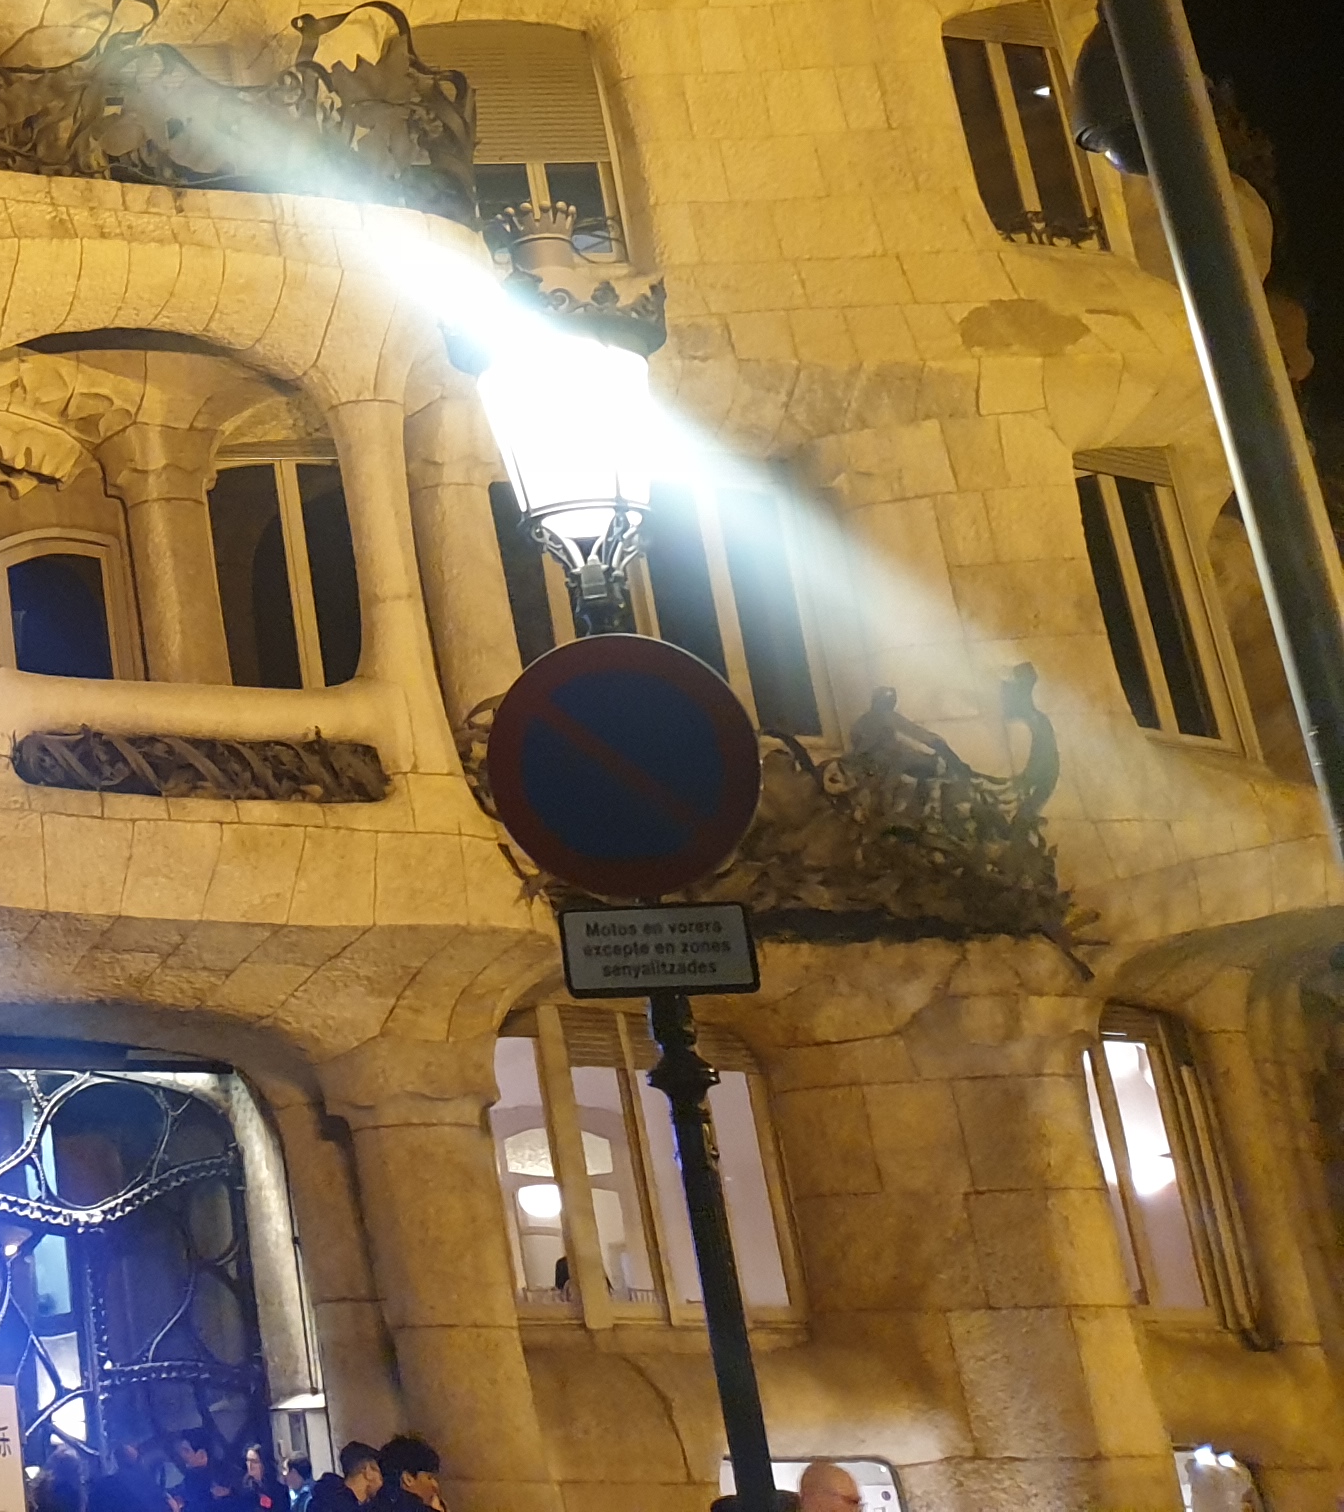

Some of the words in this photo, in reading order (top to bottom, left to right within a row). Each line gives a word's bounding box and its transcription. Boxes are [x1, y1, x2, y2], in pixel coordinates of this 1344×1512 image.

[585, 922, 637, 937] Motos
[642, 922, 662, 935] en
[582, 941, 651, 958] excepte
[654, 943, 676, 956] en
[681, 939, 731, 954] zones
